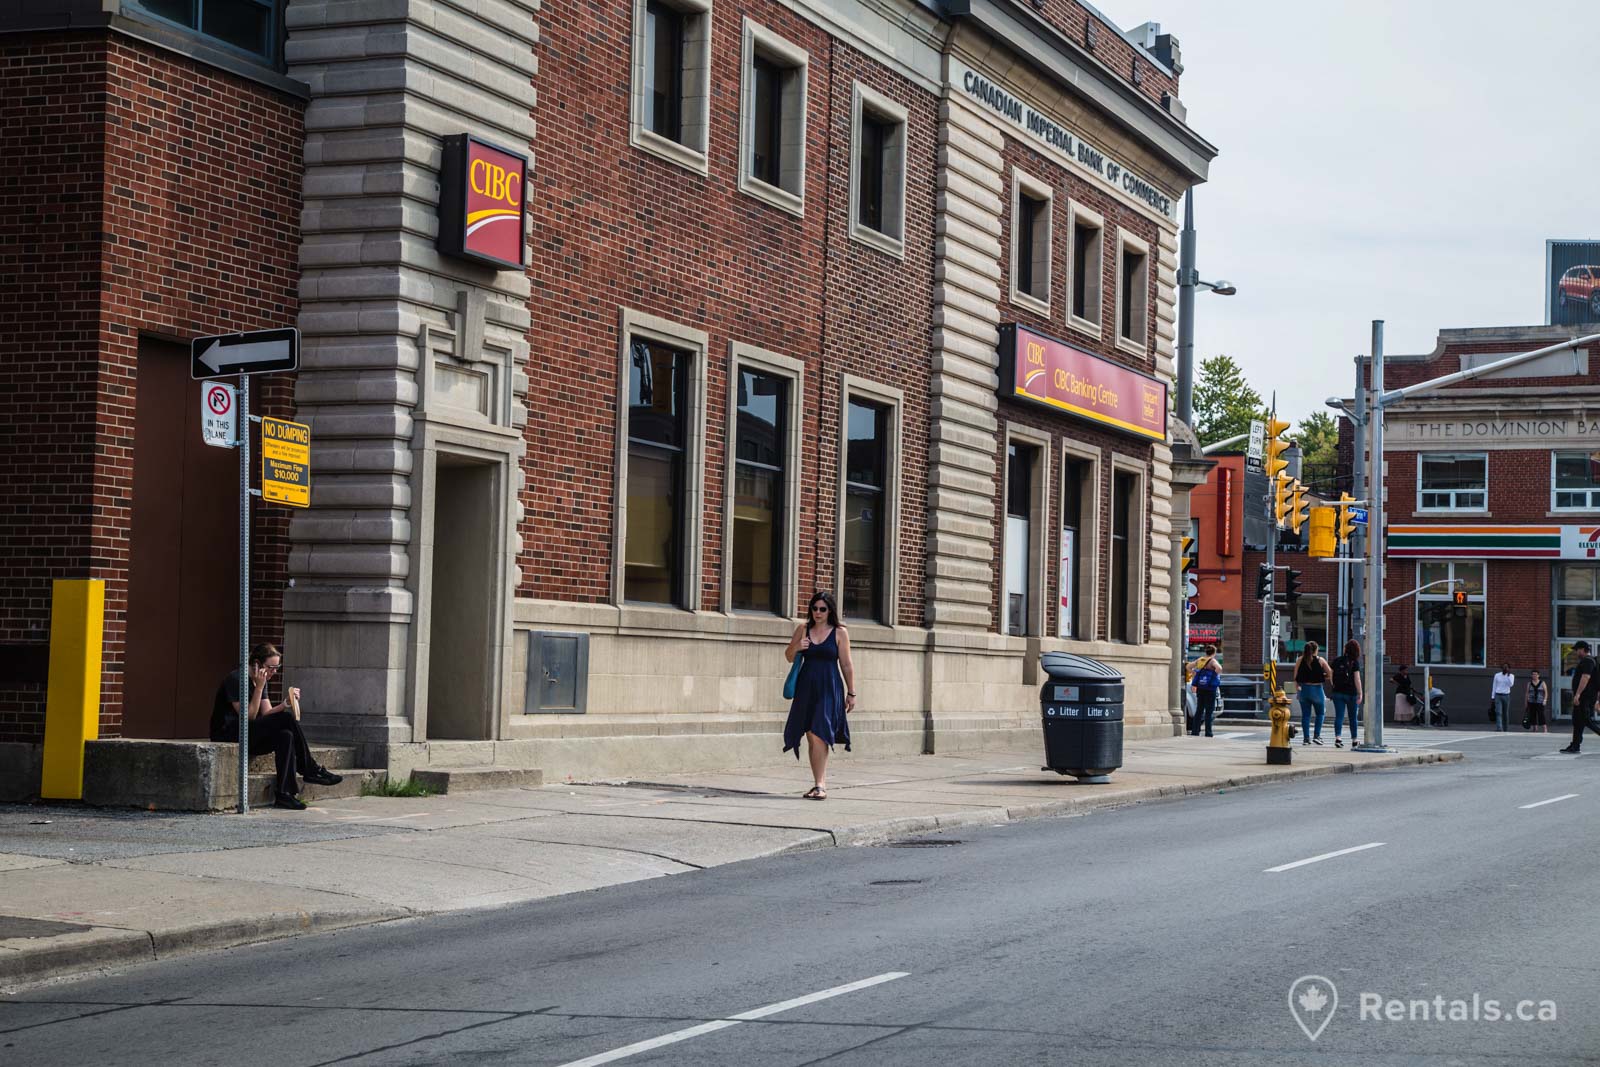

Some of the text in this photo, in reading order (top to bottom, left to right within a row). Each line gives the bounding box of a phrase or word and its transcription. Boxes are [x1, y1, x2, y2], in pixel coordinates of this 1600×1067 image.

[964, 71, 1170, 216] CANADIAN IMPERIAL BANK OF COMMERCE
[470, 158, 520, 207] CIBC
[1027, 341, 1046, 367] CIBC
[1054, 368, 1118, 409] CIBC Banking Centre
[207, 419, 230, 430] IN THIS
[265, 422, 308, 443] NO DUMPING
[1416, 422, 1456, 437] THE
[1462, 421, 1567, 437] DOMINION
[211, 431, 226, 440] LANE
[270, 459, 303, 473] Maximum Fine
[274, 468, 299, 482] $10,000
[1060, 706, 1103, 717] Litter Litter
